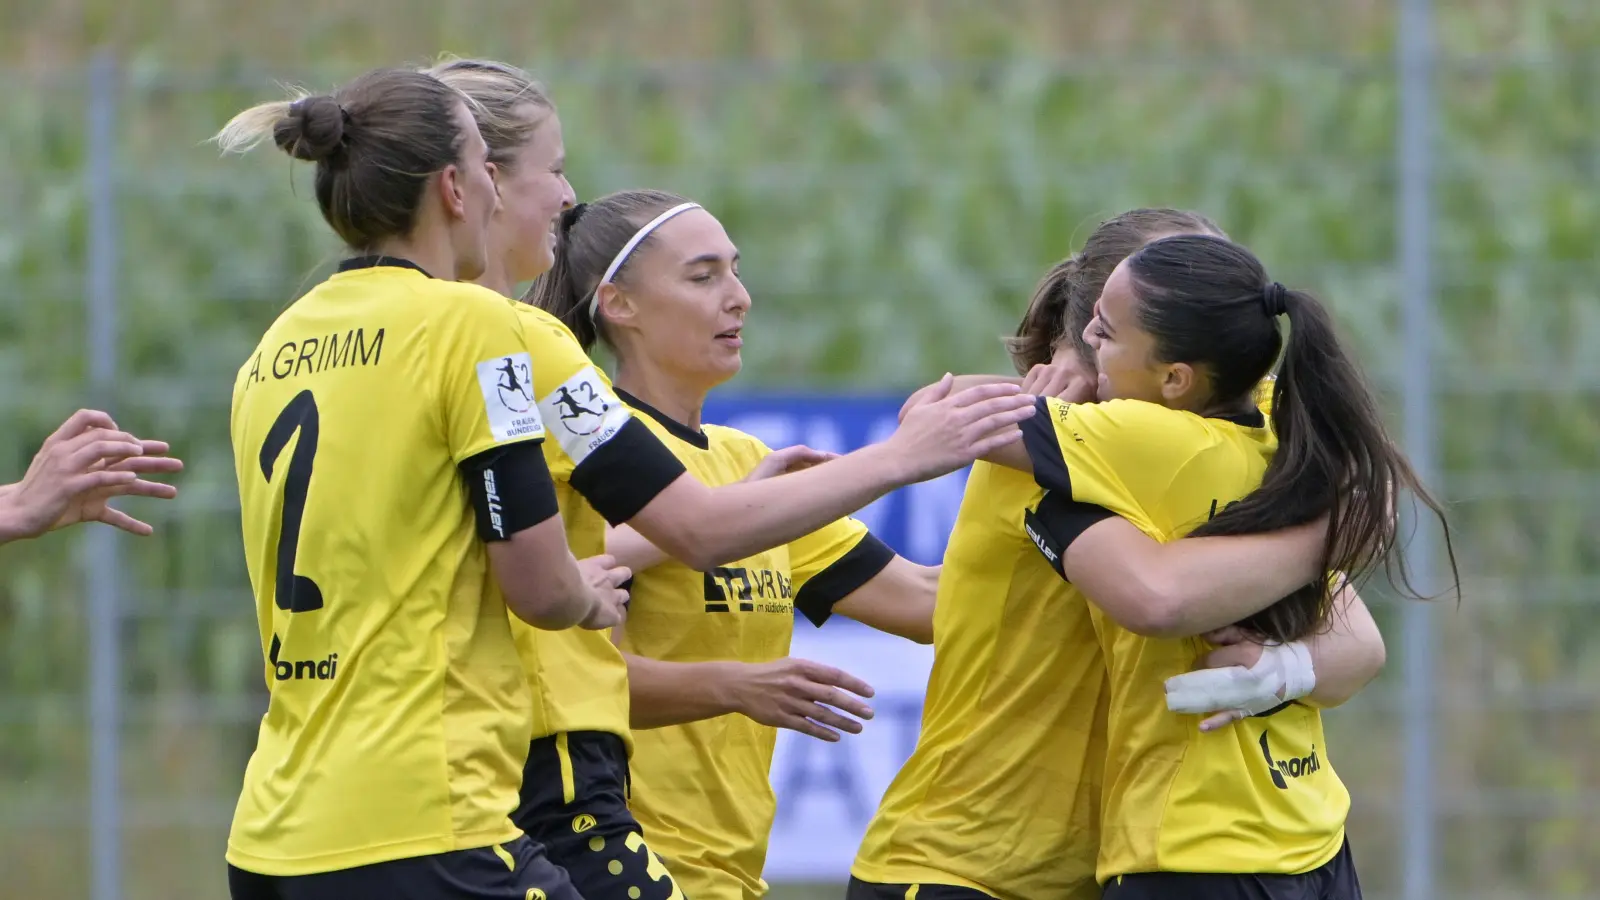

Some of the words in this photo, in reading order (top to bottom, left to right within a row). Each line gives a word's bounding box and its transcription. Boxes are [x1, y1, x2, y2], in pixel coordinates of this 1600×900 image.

[246, 350, 266, 391] A.
[272, 327, 385, 380] GRIMM
[520, 363, 531, 385] 2
[579, 380, 600, 402] 2
[511, 417, 537, 428] FRAUEN-
[588, 425, 617, 451] FRAUEN-
[259, 388, 324, 613] 2
[483, 468, 505, 539] saller
[751, 569, 777, 599] VR
[776, 570, 792, 600] Ba
[275, 653, 338, 681] ondi
